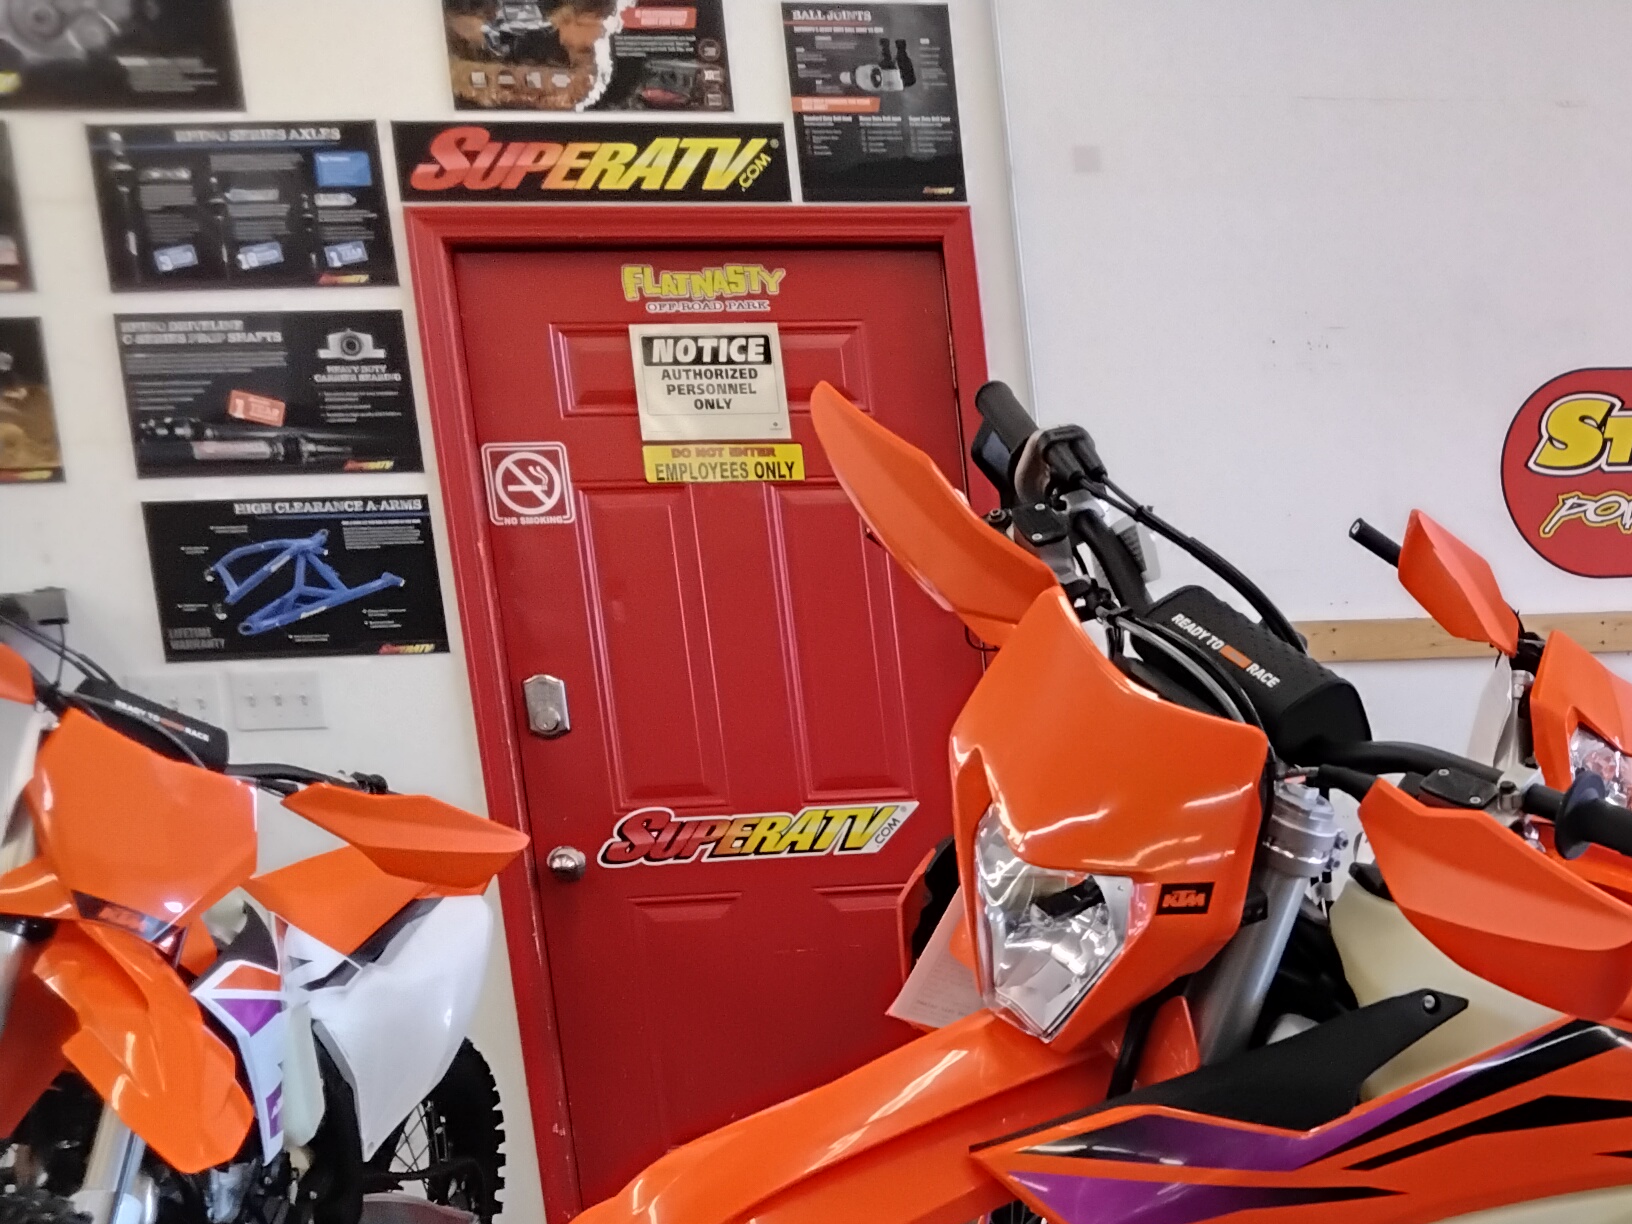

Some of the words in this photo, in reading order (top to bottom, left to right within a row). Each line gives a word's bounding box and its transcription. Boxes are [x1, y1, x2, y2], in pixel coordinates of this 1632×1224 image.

[410, 126, 768, 191] SUPERATV
[621, 264, 786, 301] FLATNASTY
[727, 301, 769, 311] PARK
[652, 337, 766, 363] NOTICE
[661, 368, 759, 381] AUTHORIZED
[666, 383, 757, 396] PERSONNEL
[693, 398, 733, 411] ONLY
[671, 447, 692, 459] DO
[695, 447, 725, 458] NOT
[729, 446, 777, 458] ENTER
[655, 461, 749, 481] EMPLOYEES
[753, 460, 795, 480] ONLY
[233, 502, 273, 515] HIGH
[274, 500, 363, 514] CLEARANCE
[365, 499, 422, 512] A-ARMS
[503, 517, 519, 526] NO
[520, 515, 564, 526] SMOKING
[1171, 613, 1211, 641] READY
[1205, 635, 1225, 651] TO
[1246, 663, 1281, 689] RACE
[600, 805, 900, 866] SUPERATV
[1161, 889, 1207, 908] KTM
